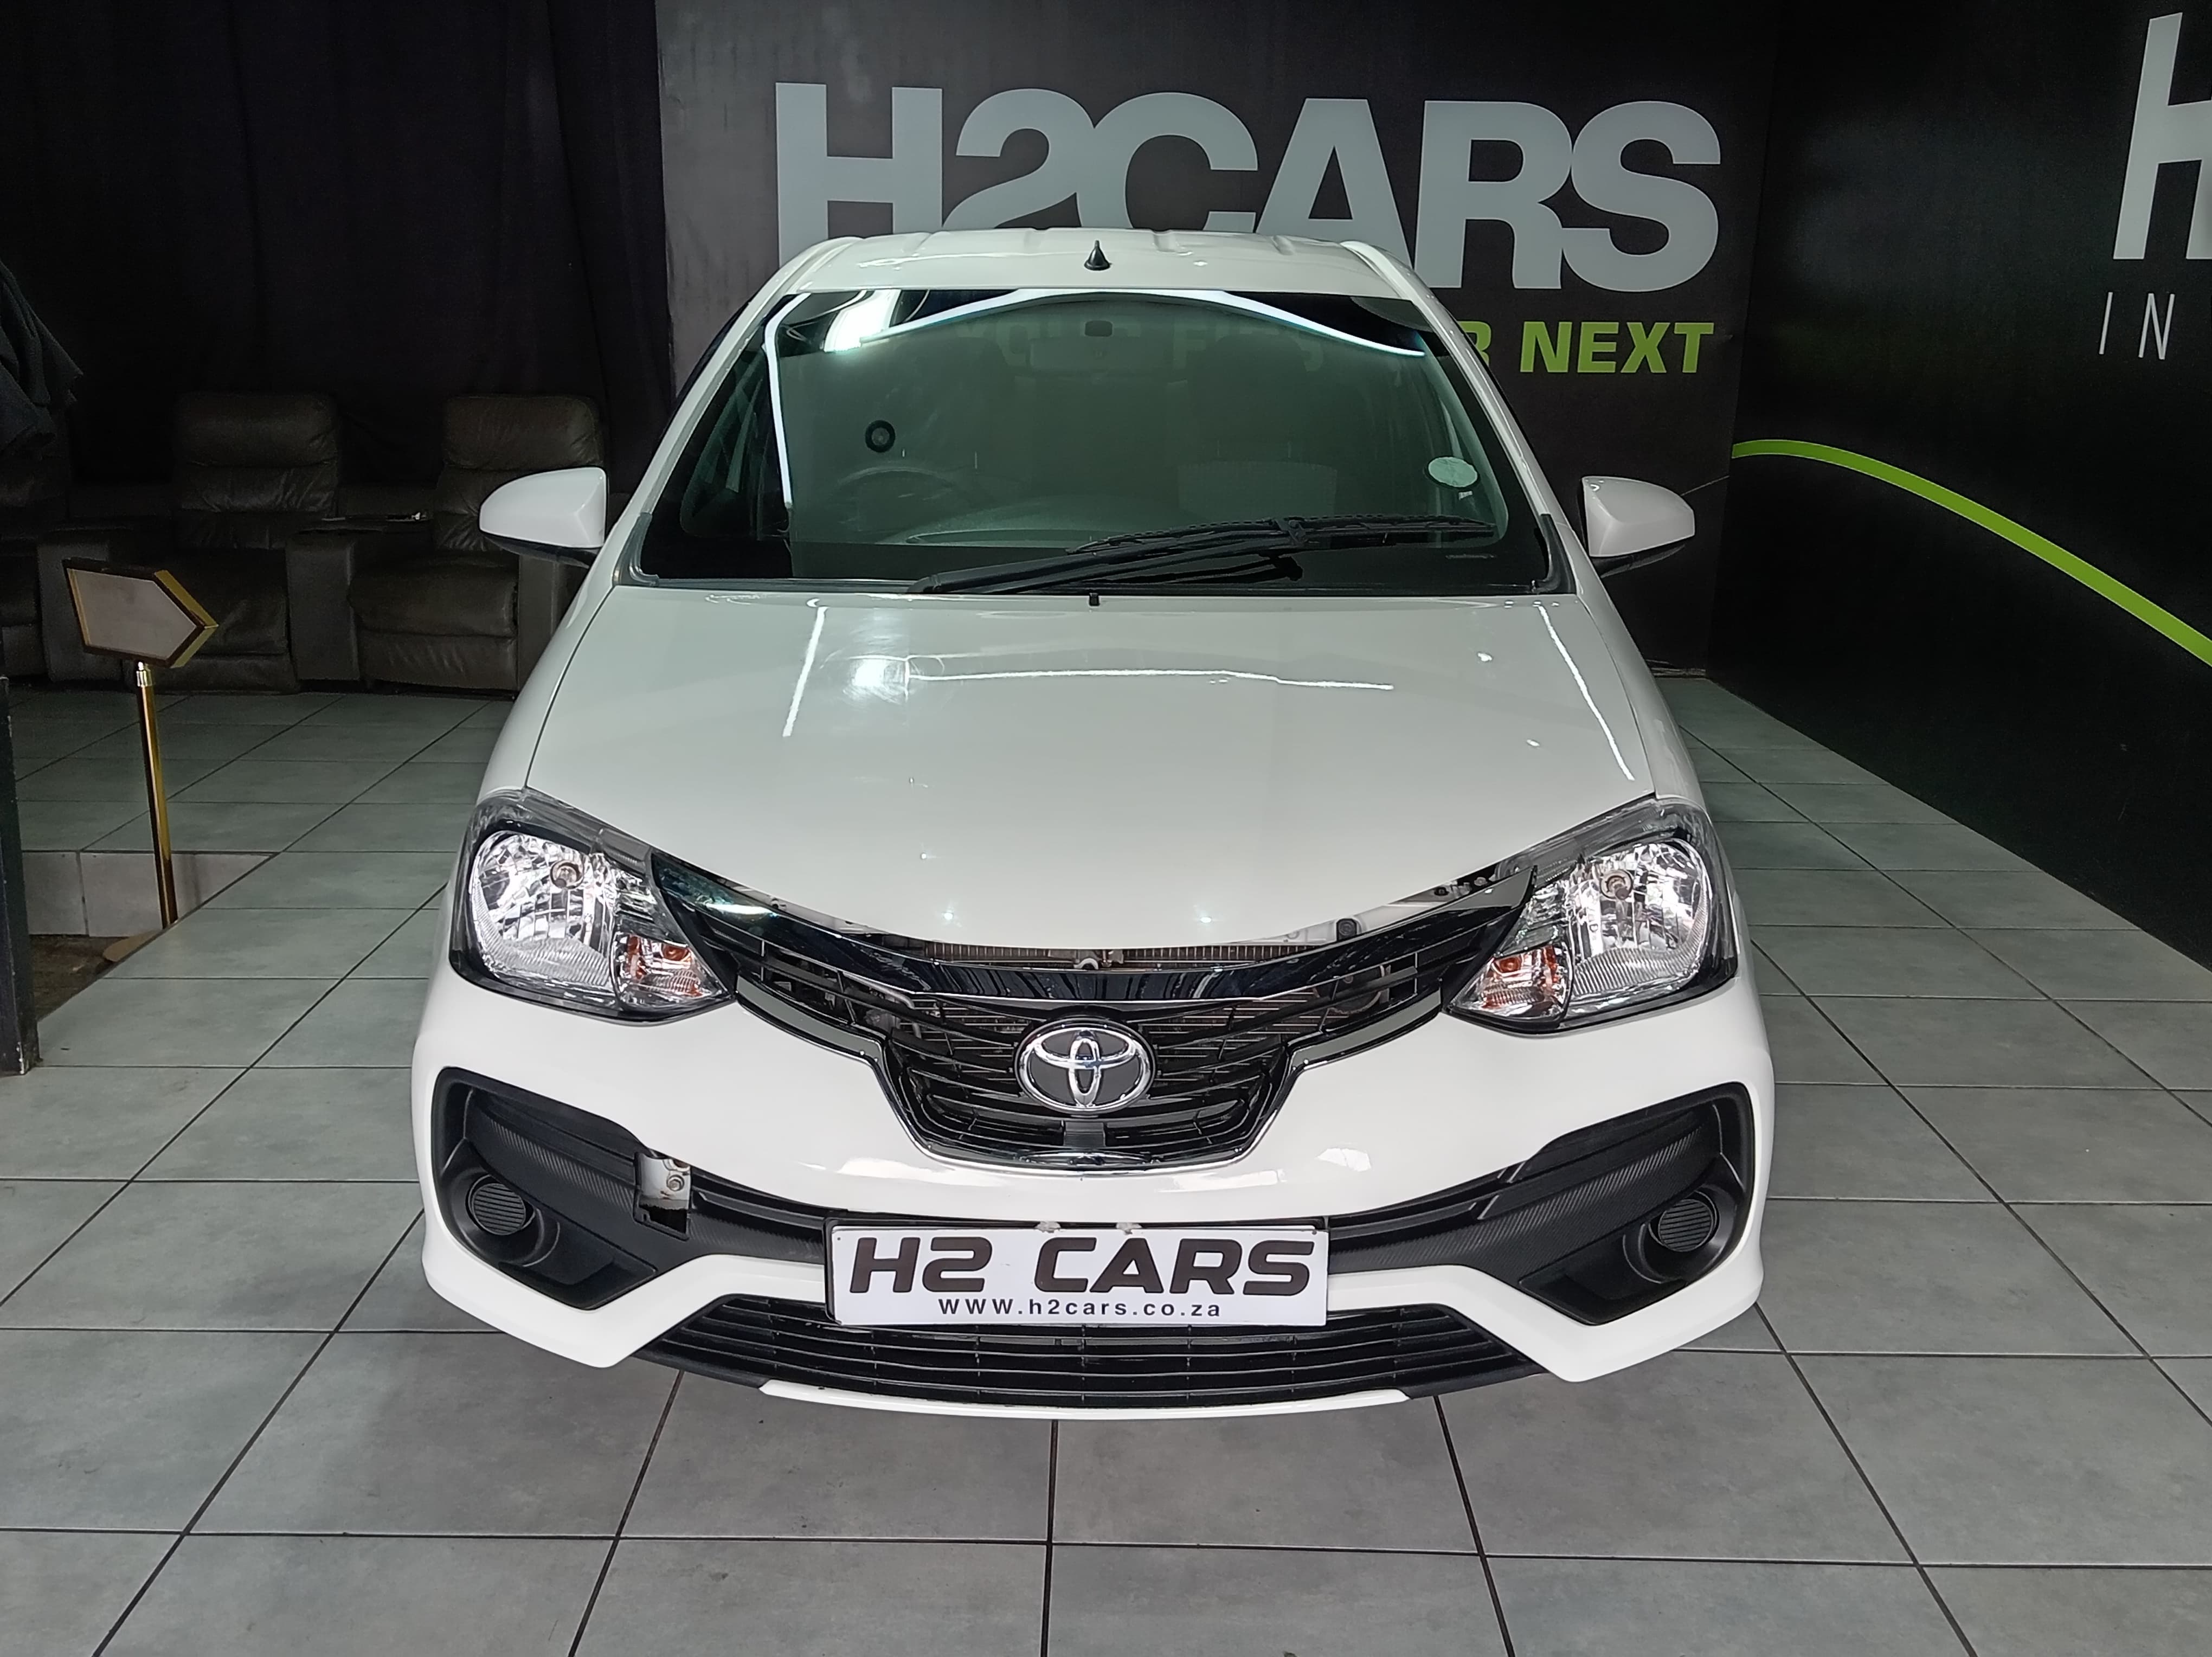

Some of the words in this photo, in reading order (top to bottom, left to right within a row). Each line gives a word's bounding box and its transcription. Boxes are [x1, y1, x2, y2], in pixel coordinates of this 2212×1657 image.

[775, 82, 1721, 291] H2CARS
[1520, 321, 1715, 373] NEXT
[849, 1237, 993, 1294] H2
[1034, 1237, 1315, 1296] CARS
[938, 1298, 1221, 1317] www.h2cars.co.za
